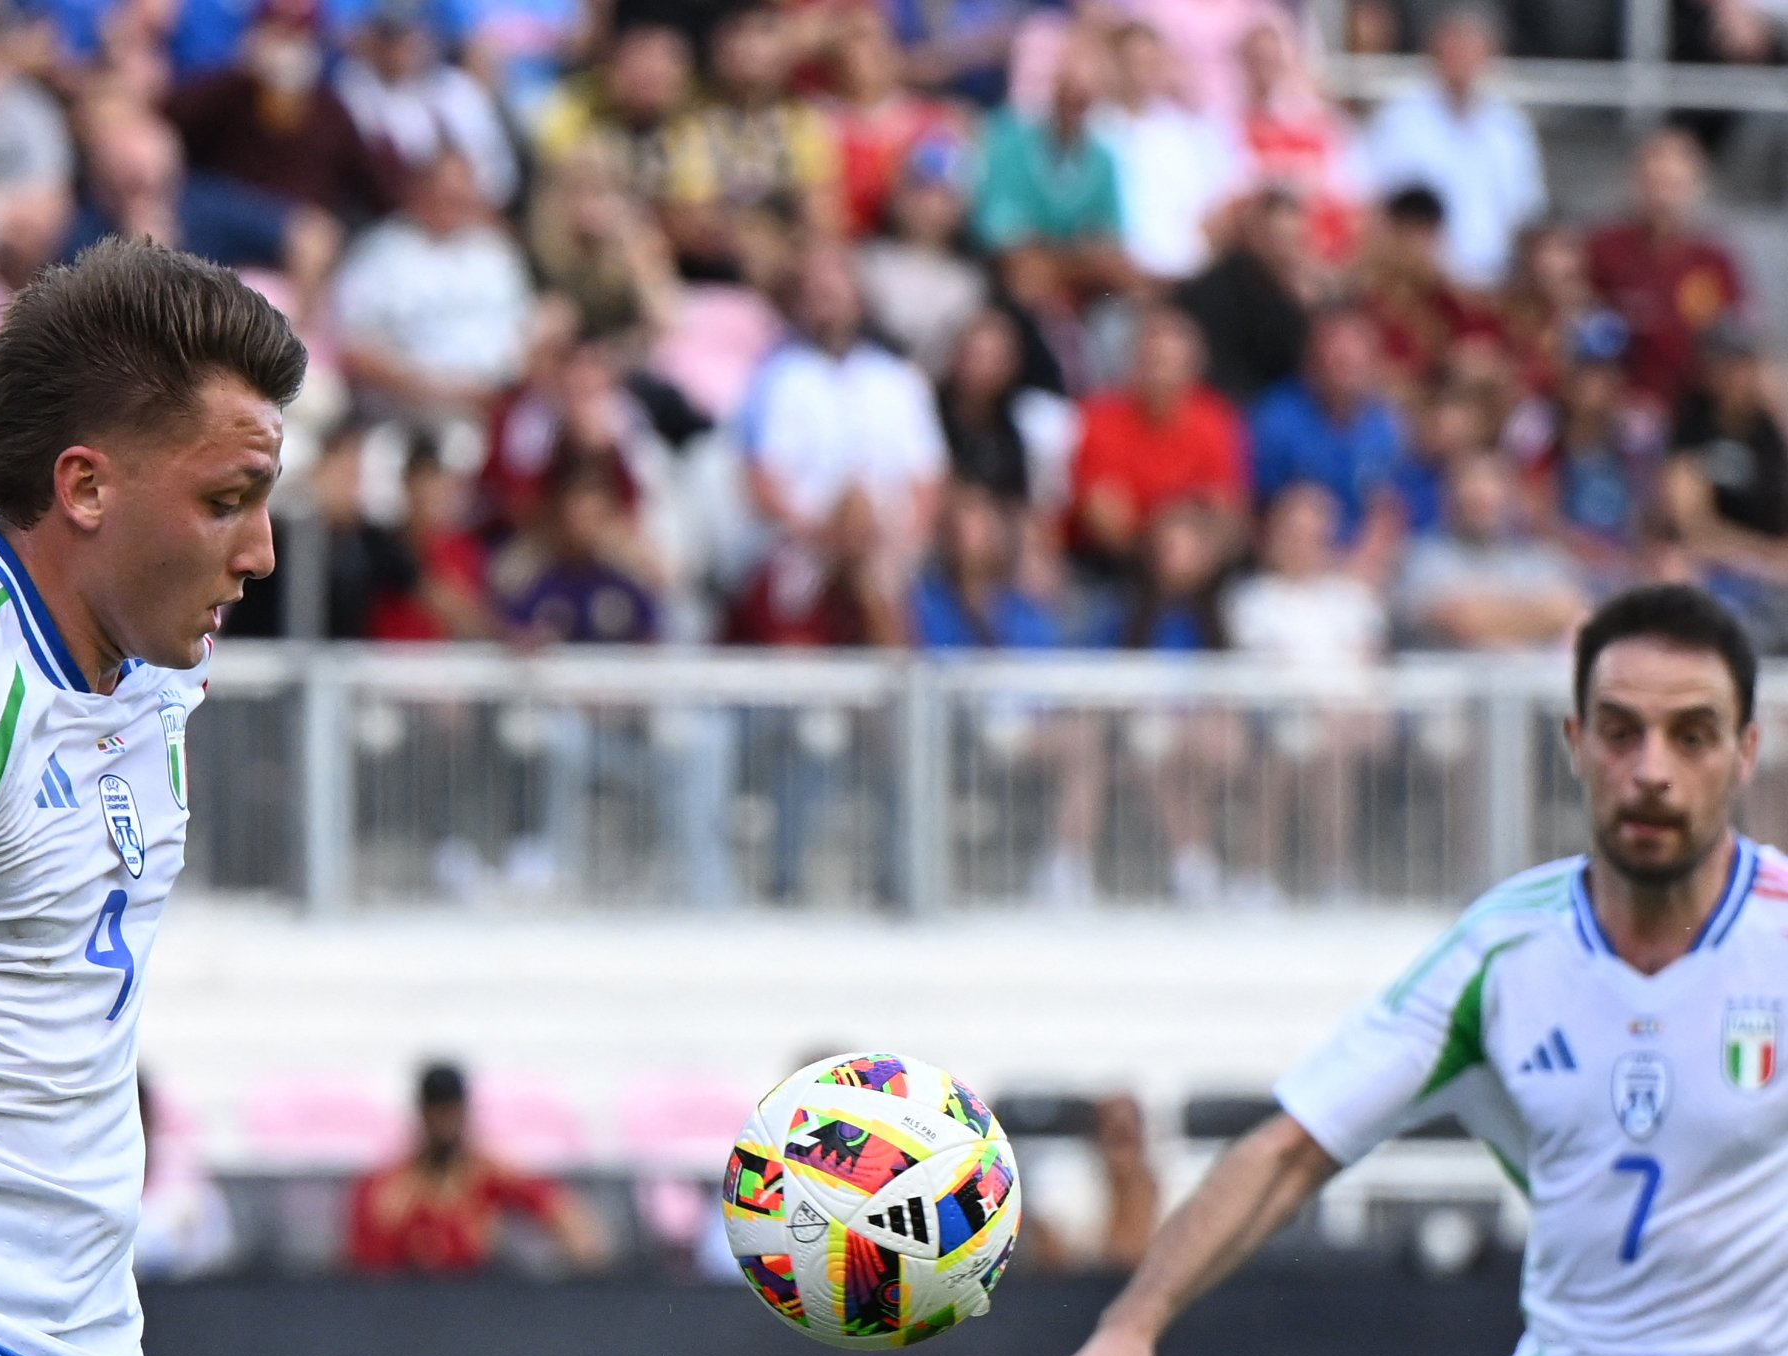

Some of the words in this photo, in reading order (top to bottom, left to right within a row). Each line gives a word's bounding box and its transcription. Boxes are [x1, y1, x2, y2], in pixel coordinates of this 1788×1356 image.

[85, 889, 135, 1022] 9
[903, 1116, 920, 1129] MLS
[921, 1126, 937, 1140] PRO
[1614, 1155, 1662, 1265] 7
